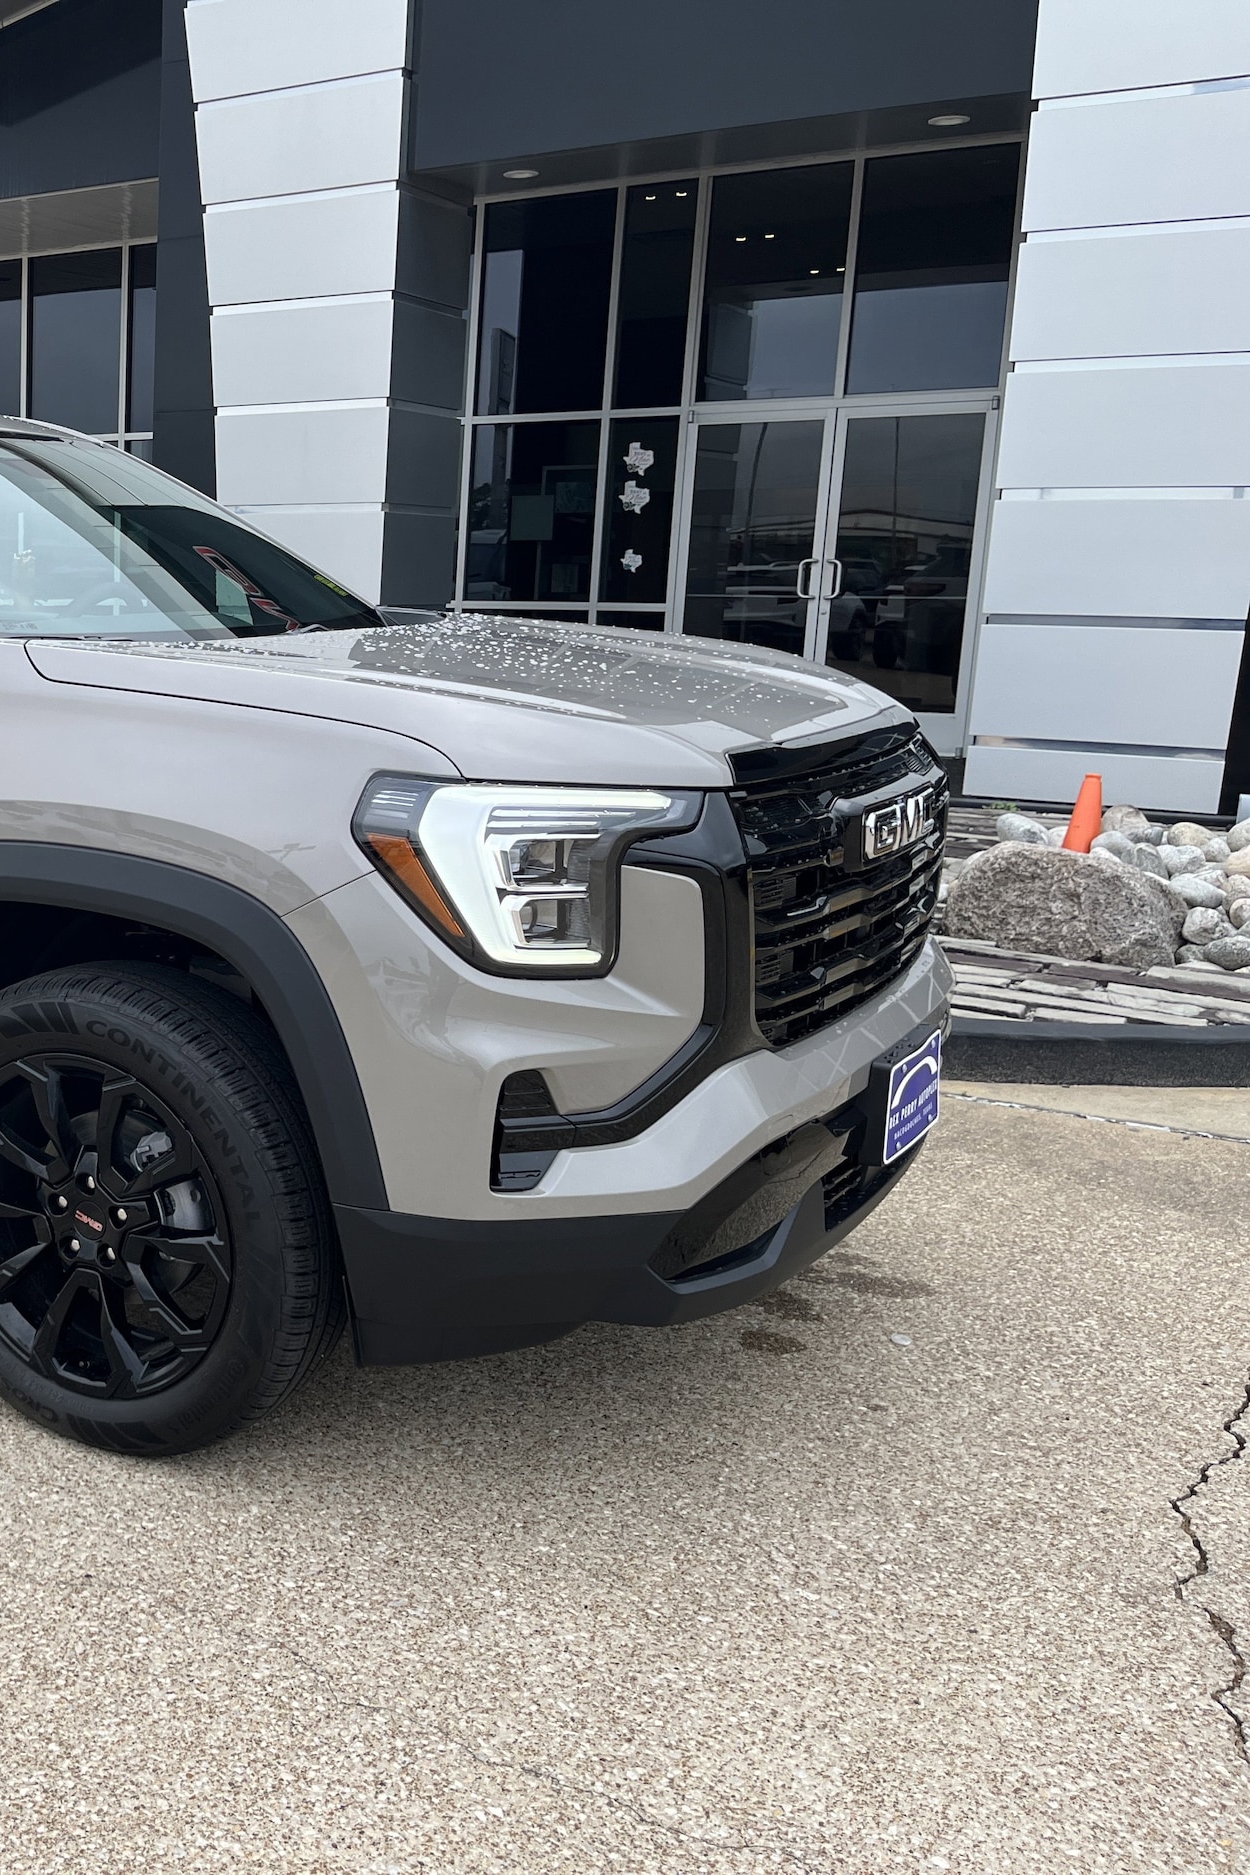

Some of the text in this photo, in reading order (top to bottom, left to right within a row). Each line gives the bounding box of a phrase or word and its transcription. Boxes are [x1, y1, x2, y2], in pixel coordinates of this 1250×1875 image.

[85, 1019, 260, 1227] CONTINENTAL
[888, 1078, 938, 1130] REX PERRY AUTOPLEX
